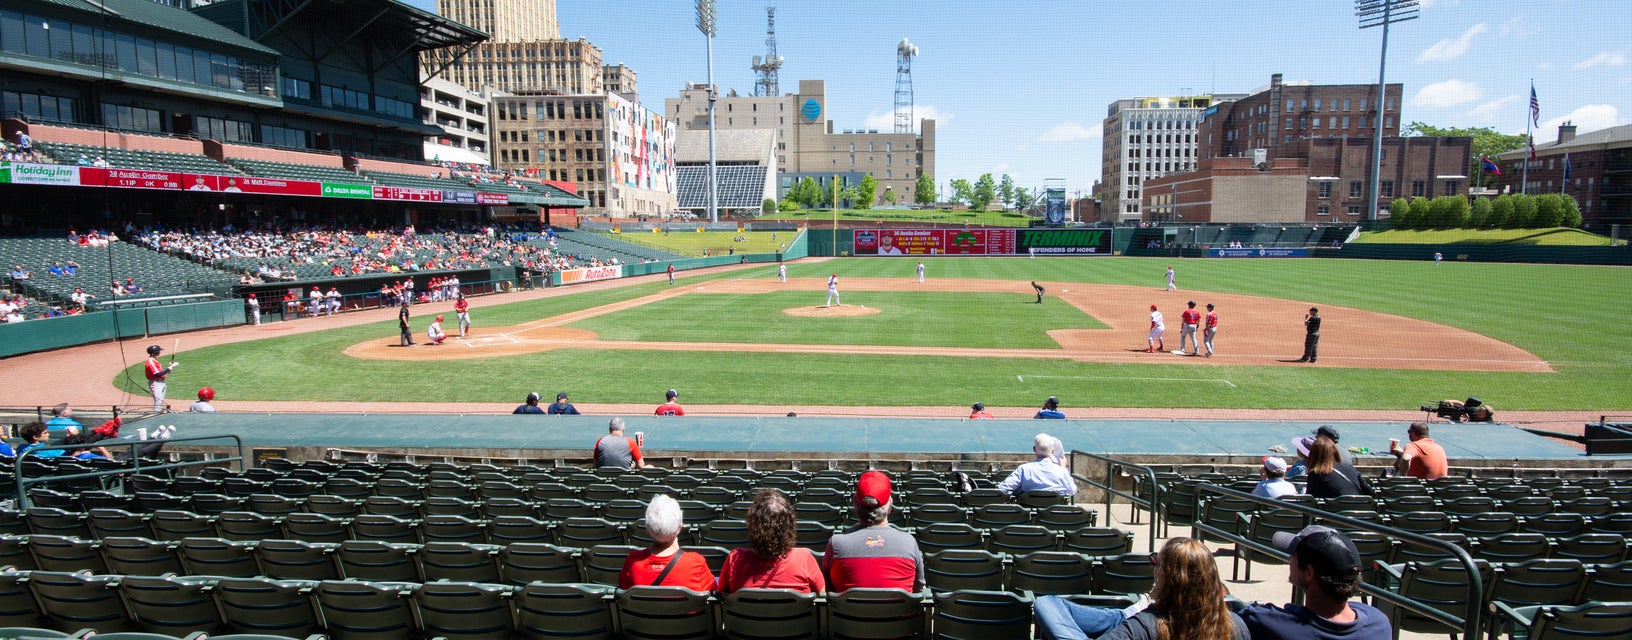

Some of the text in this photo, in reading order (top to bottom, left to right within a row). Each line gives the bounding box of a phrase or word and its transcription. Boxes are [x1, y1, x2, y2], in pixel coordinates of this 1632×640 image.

[15, 164, 72, 177] Holiday Inn
[119, 171, 140, 179] Austin
[1022, 230, 1104, 247] TERMINIX
[585, 267, 616, 279] AutoZone
